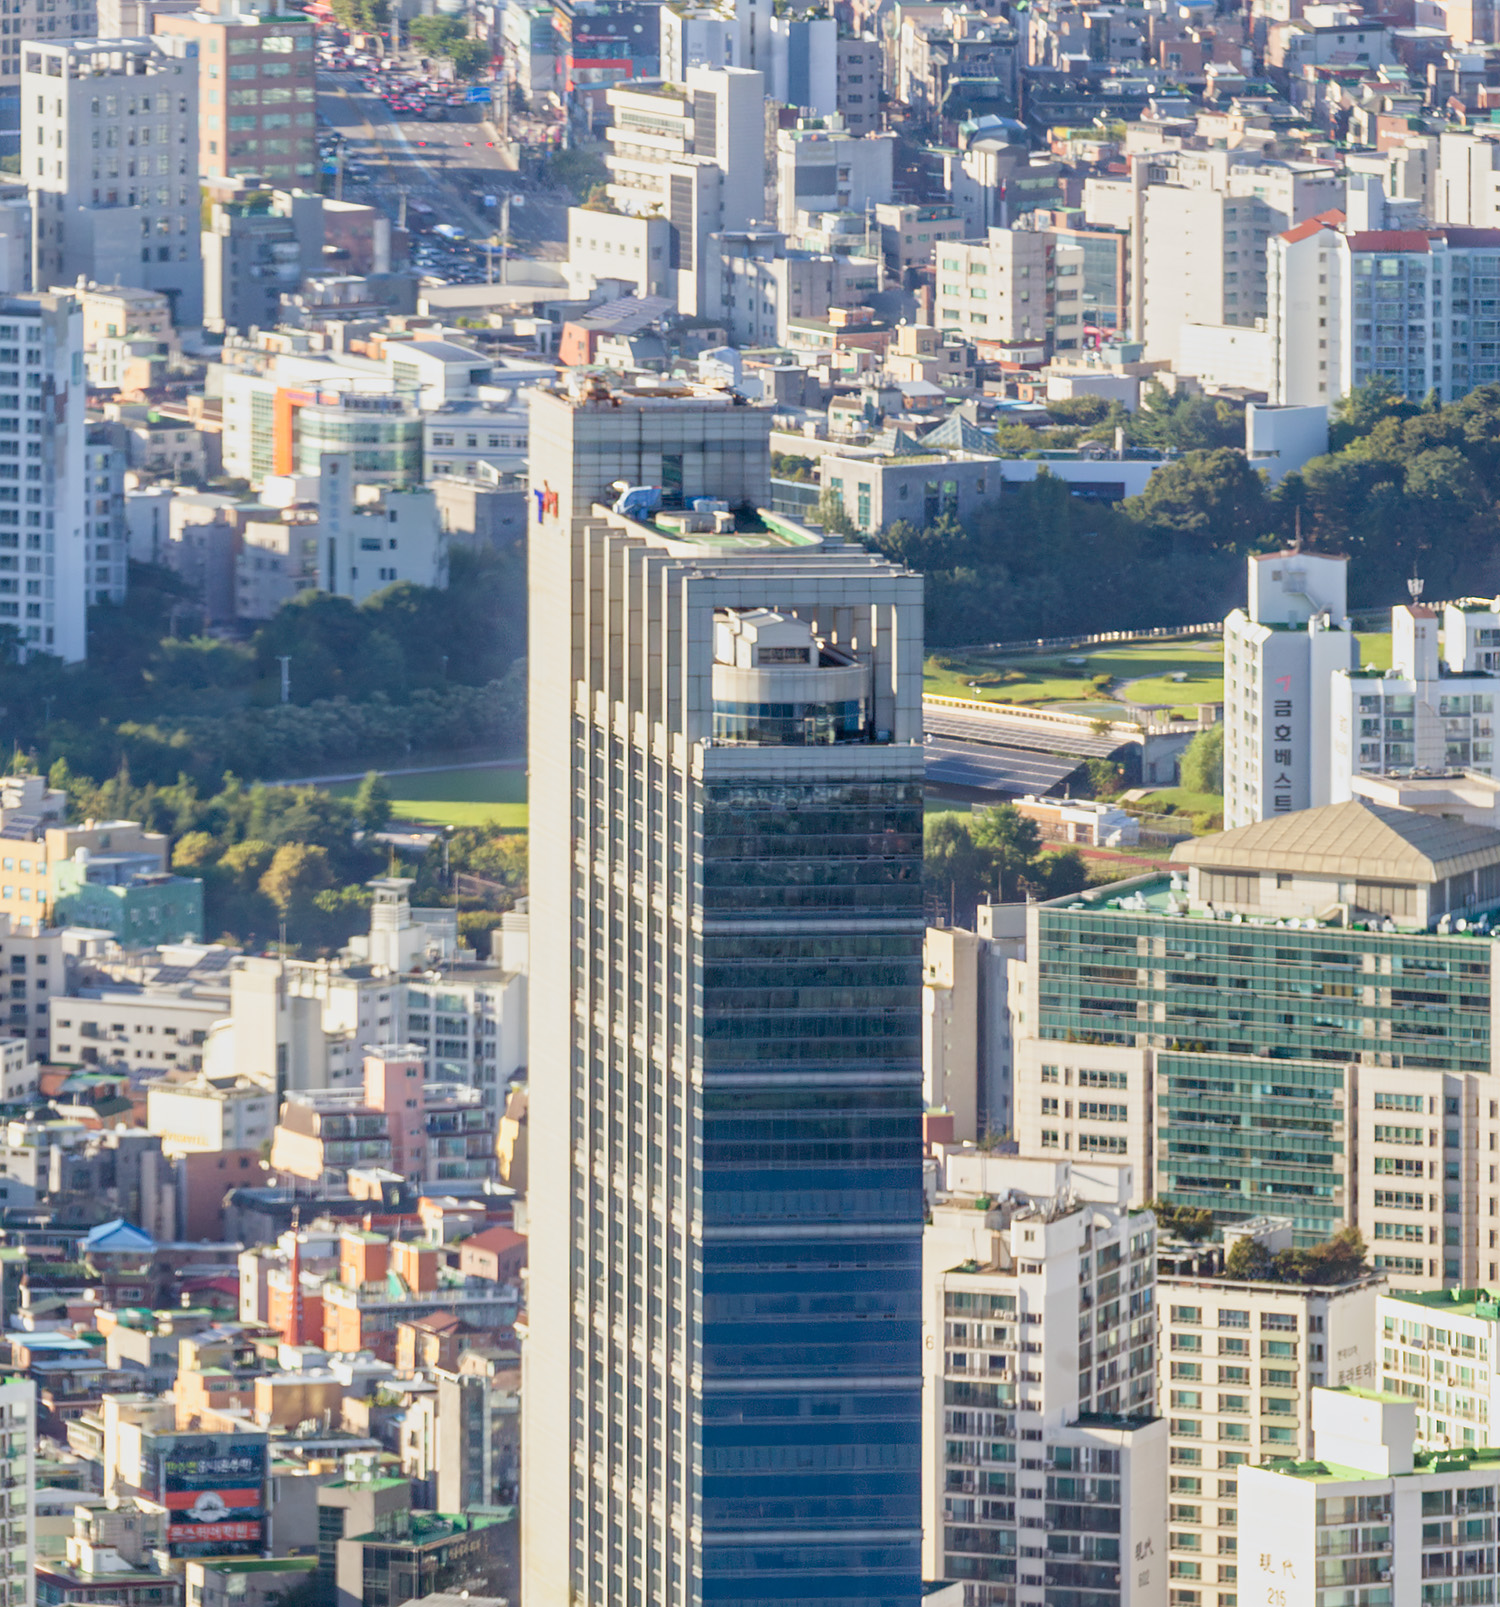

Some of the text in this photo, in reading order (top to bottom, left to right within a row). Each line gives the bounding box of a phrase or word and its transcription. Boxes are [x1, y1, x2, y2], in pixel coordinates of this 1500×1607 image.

[1273, 699, 1292, 812] 금호베스트
[1259, 1552, 1297, 1580] 現代
[1267, 1587, 1287, 1607] 215
